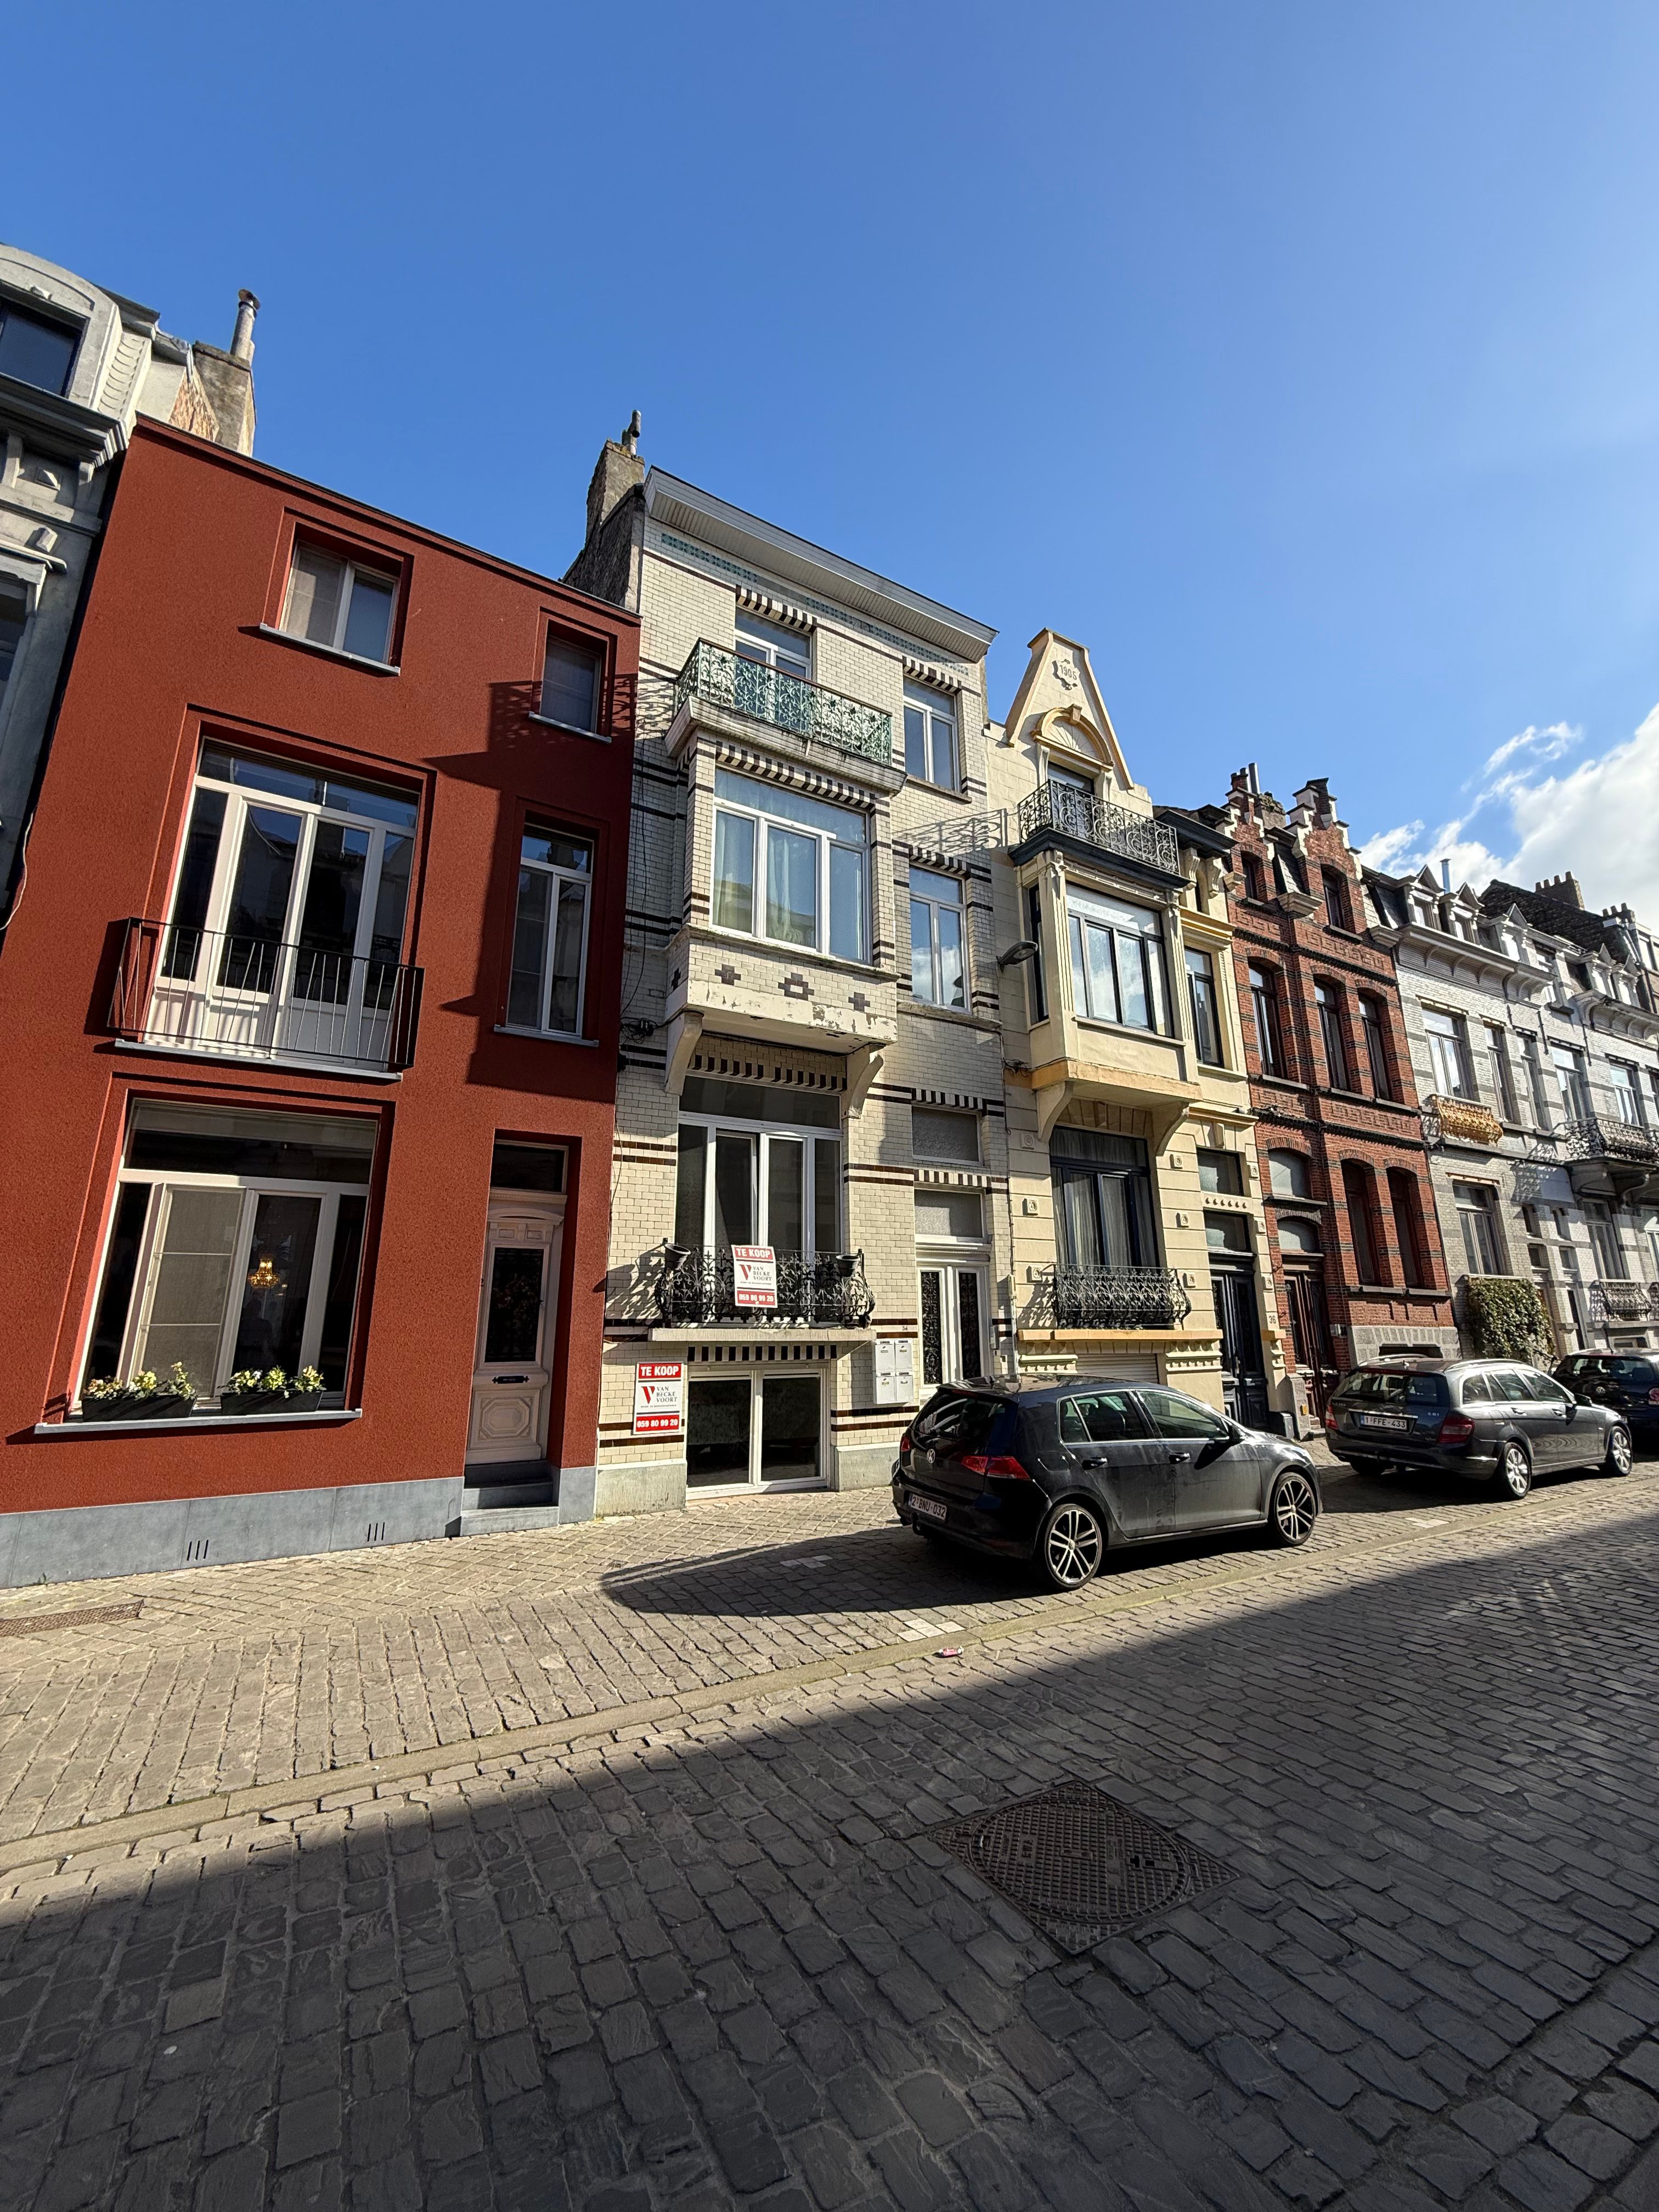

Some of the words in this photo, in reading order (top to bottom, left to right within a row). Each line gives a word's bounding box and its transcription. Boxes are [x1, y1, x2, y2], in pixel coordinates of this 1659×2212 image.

[1059, 664, 1077, 680] 1905
[736, 1248, 747, 1256] TE
[749, 1249, 770, 1258] KOOP
[1268, 1315, 1276, 1324] 36
[641, 1366, 652, 1376] TE
[654, 1365, 679, 1376] KOOP
[912, 1496, 945, 1517] 2-BNU-032
